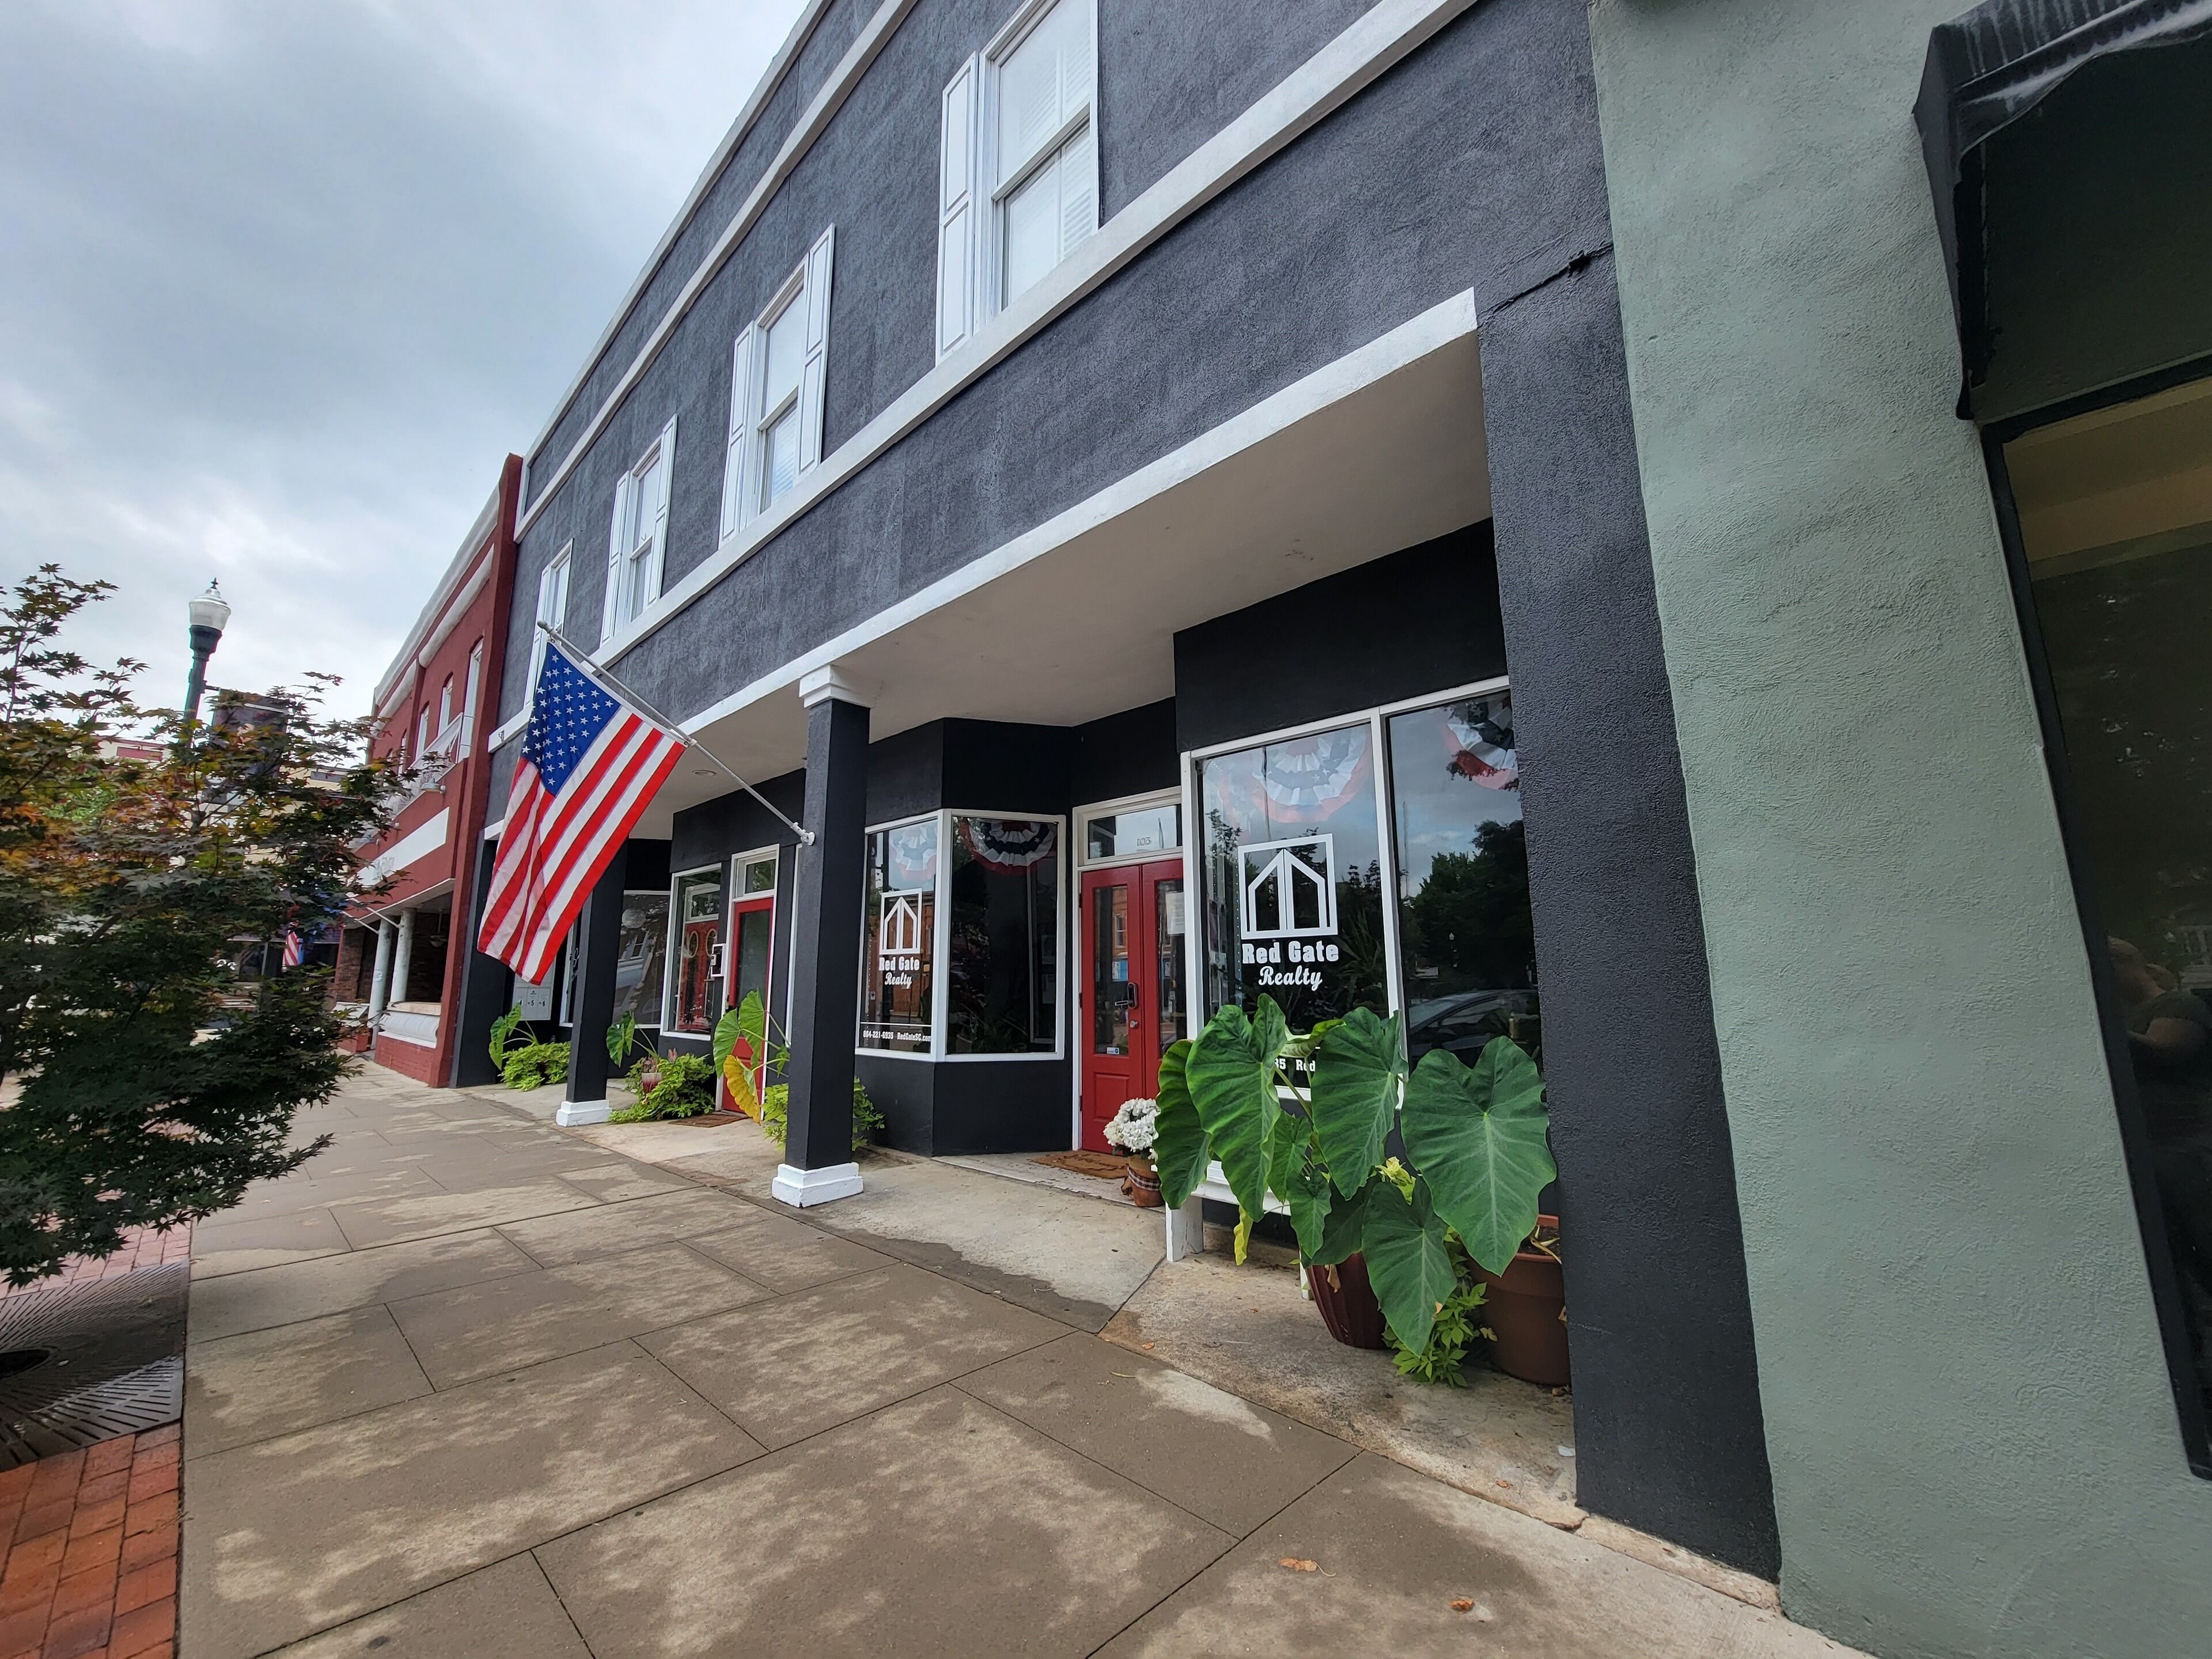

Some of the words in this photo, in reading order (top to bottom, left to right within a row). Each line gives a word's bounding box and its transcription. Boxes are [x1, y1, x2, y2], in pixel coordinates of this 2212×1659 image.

[1242, 942, 1281, 964] Red
[1288, 940, 1339, 963] Gate
[878, 957, 896, 971] Red
[899, 956, 920, 971] Gate
[884, 972, 912, 989] Realty
[1258, 965, 1323, 991] Realty
